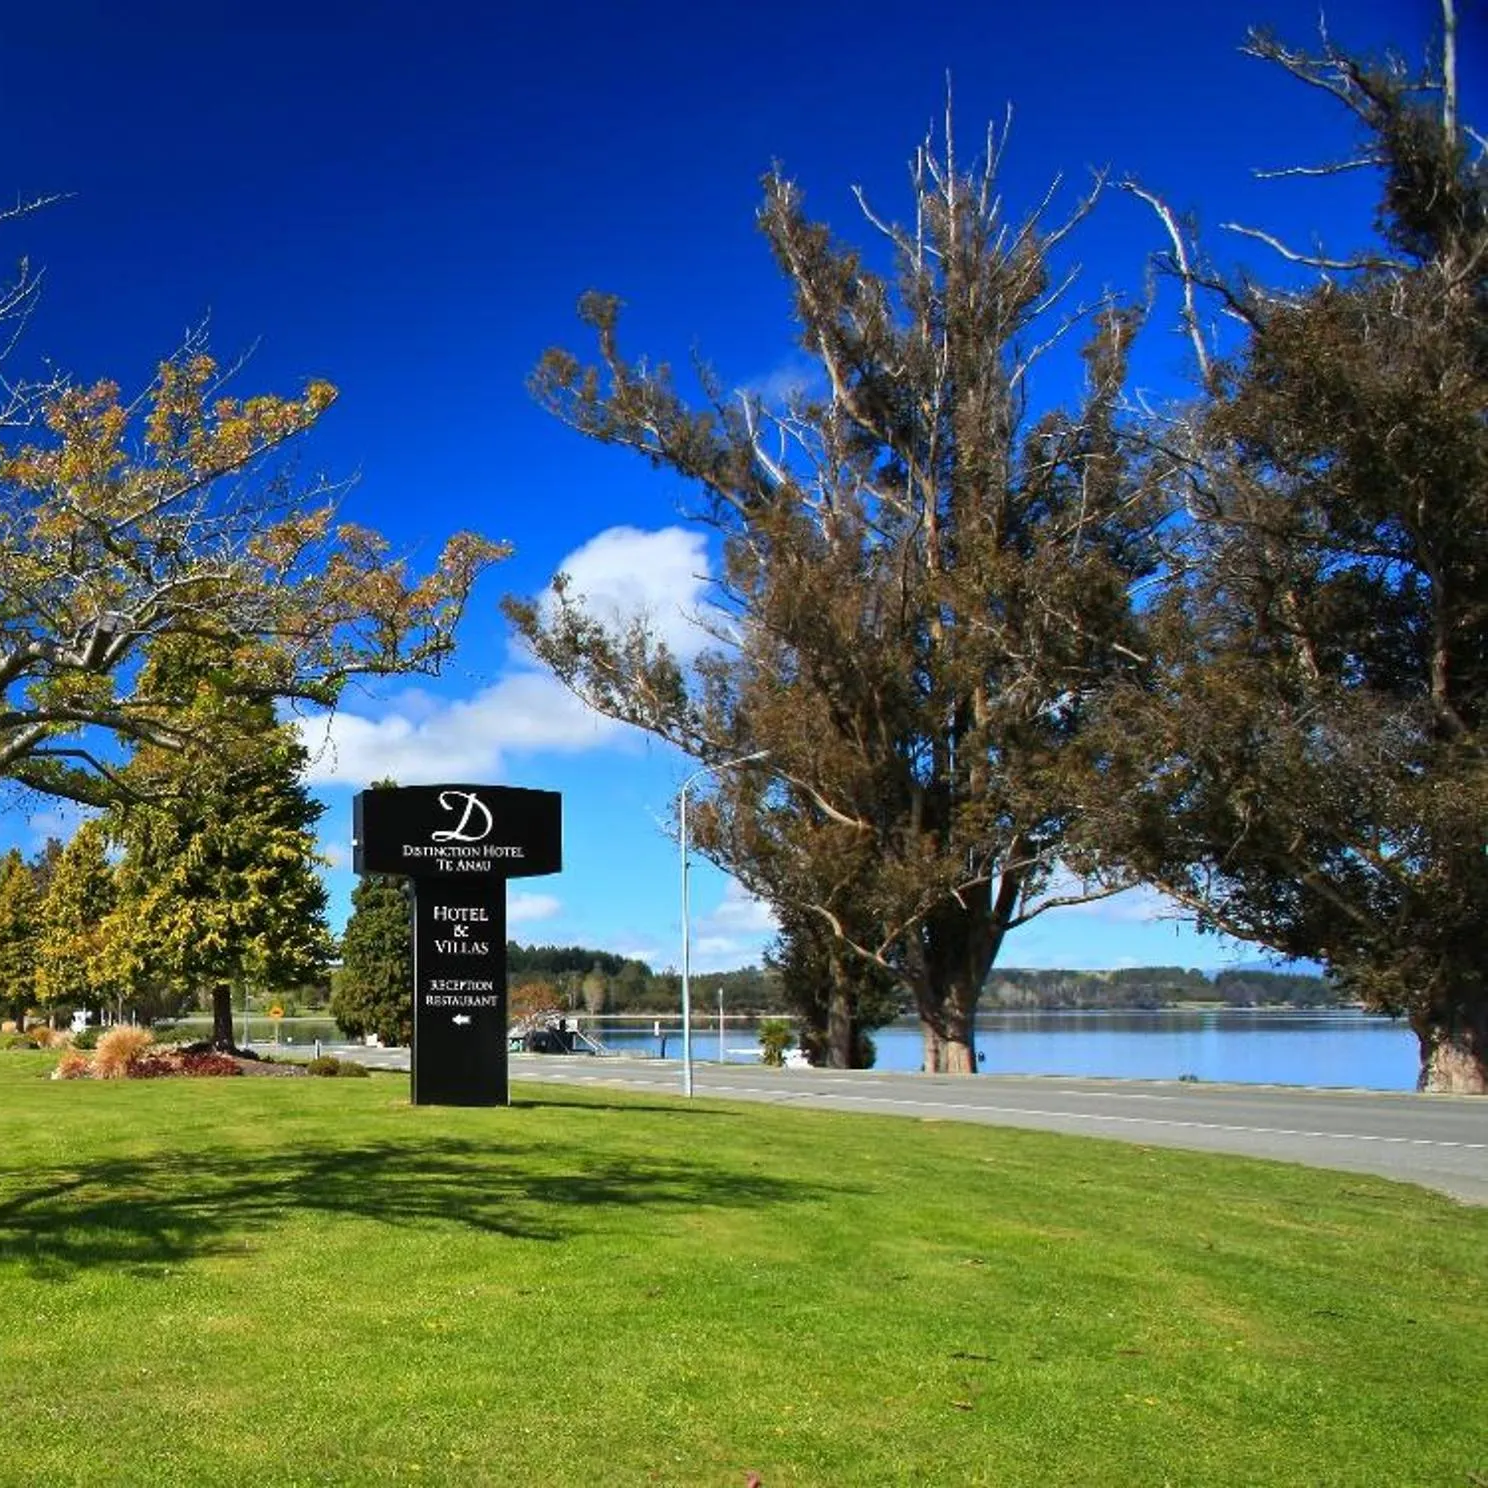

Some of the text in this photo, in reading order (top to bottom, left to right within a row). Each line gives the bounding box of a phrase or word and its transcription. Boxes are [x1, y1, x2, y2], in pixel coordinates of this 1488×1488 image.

[402, 844, 525, 858] DISTINCTION HOTEL
[436, 858, 491, 872] TE ANAU
[433, 905, 489, 922] HOTEL
[453, 923, 470, 938] &
[434, 939, 490, 955] VILLAS
[429, 979, 493, 991] RECEPTION
[425, 995, 498, 1007] RESTAURANT
